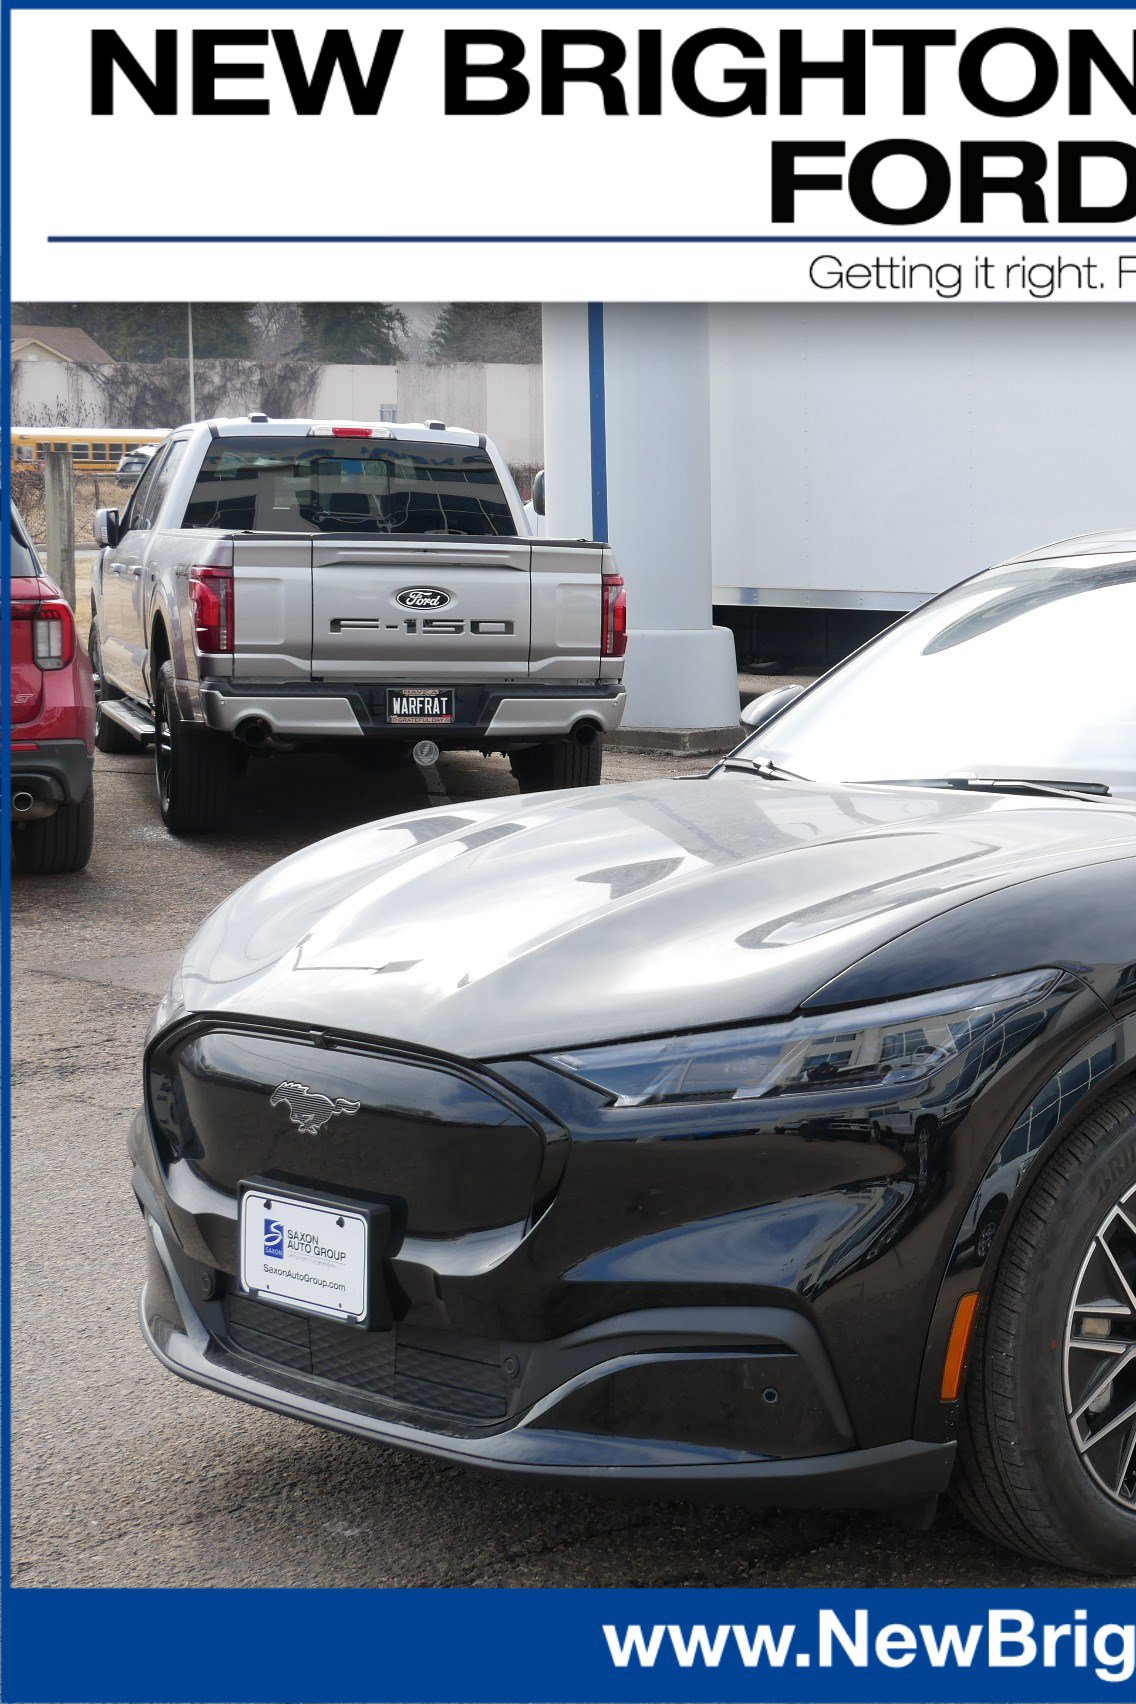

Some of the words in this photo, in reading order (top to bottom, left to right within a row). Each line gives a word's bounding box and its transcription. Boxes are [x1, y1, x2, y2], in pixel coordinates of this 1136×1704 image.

[405, 590, 441, 607] Ford
[330, 617, 515, 636] F-150
[393, 697, 448, 715] WARFRAT
[287, 1229, 319, 1245] SAXON
[287, 1240, 312, 1254] AUTO
[313, 1245, 347, 1262] GROUP
[263, 1263, 346, 1292] SaxonAutoGroup.com
